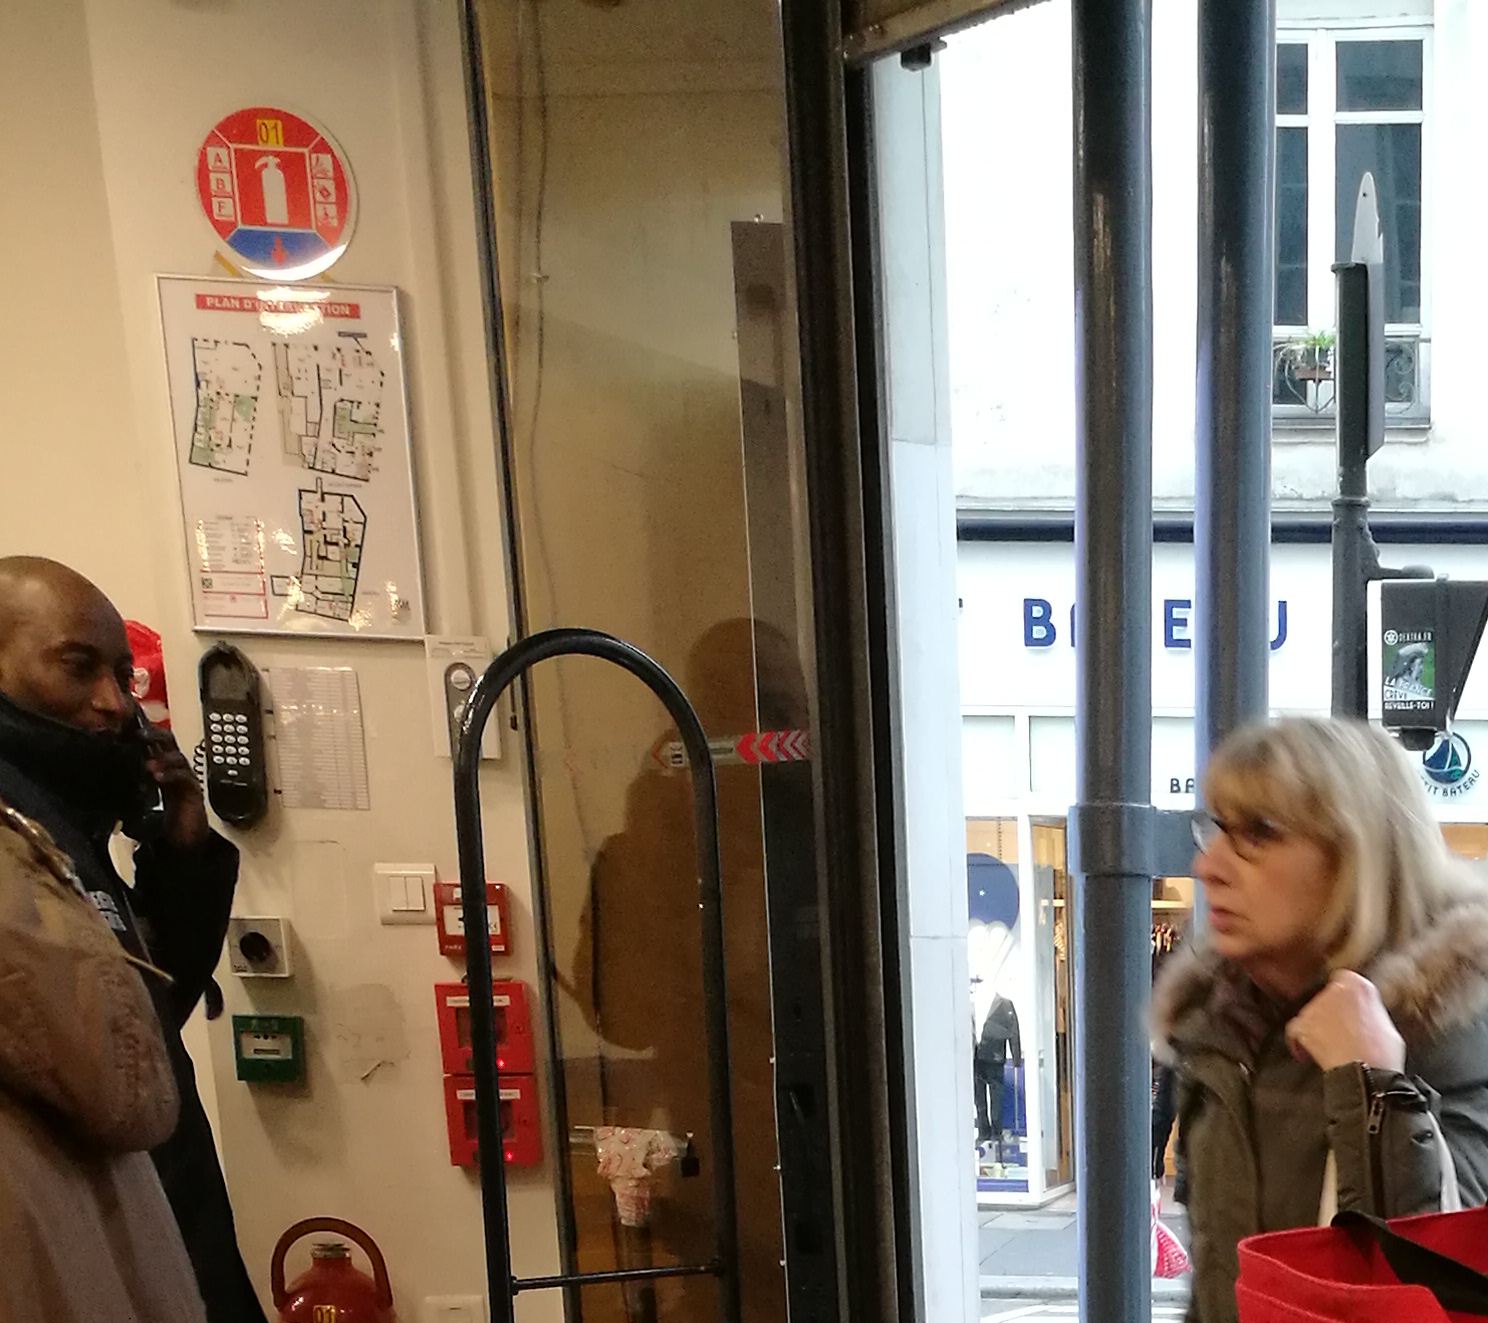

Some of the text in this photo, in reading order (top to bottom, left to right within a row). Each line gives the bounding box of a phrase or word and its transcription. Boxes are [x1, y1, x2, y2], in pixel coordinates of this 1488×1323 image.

[259, 122, 279, 144] 01
[206, 296, 240, 309] PLAN
[1442, 769, 1480, 797] BATEAU
